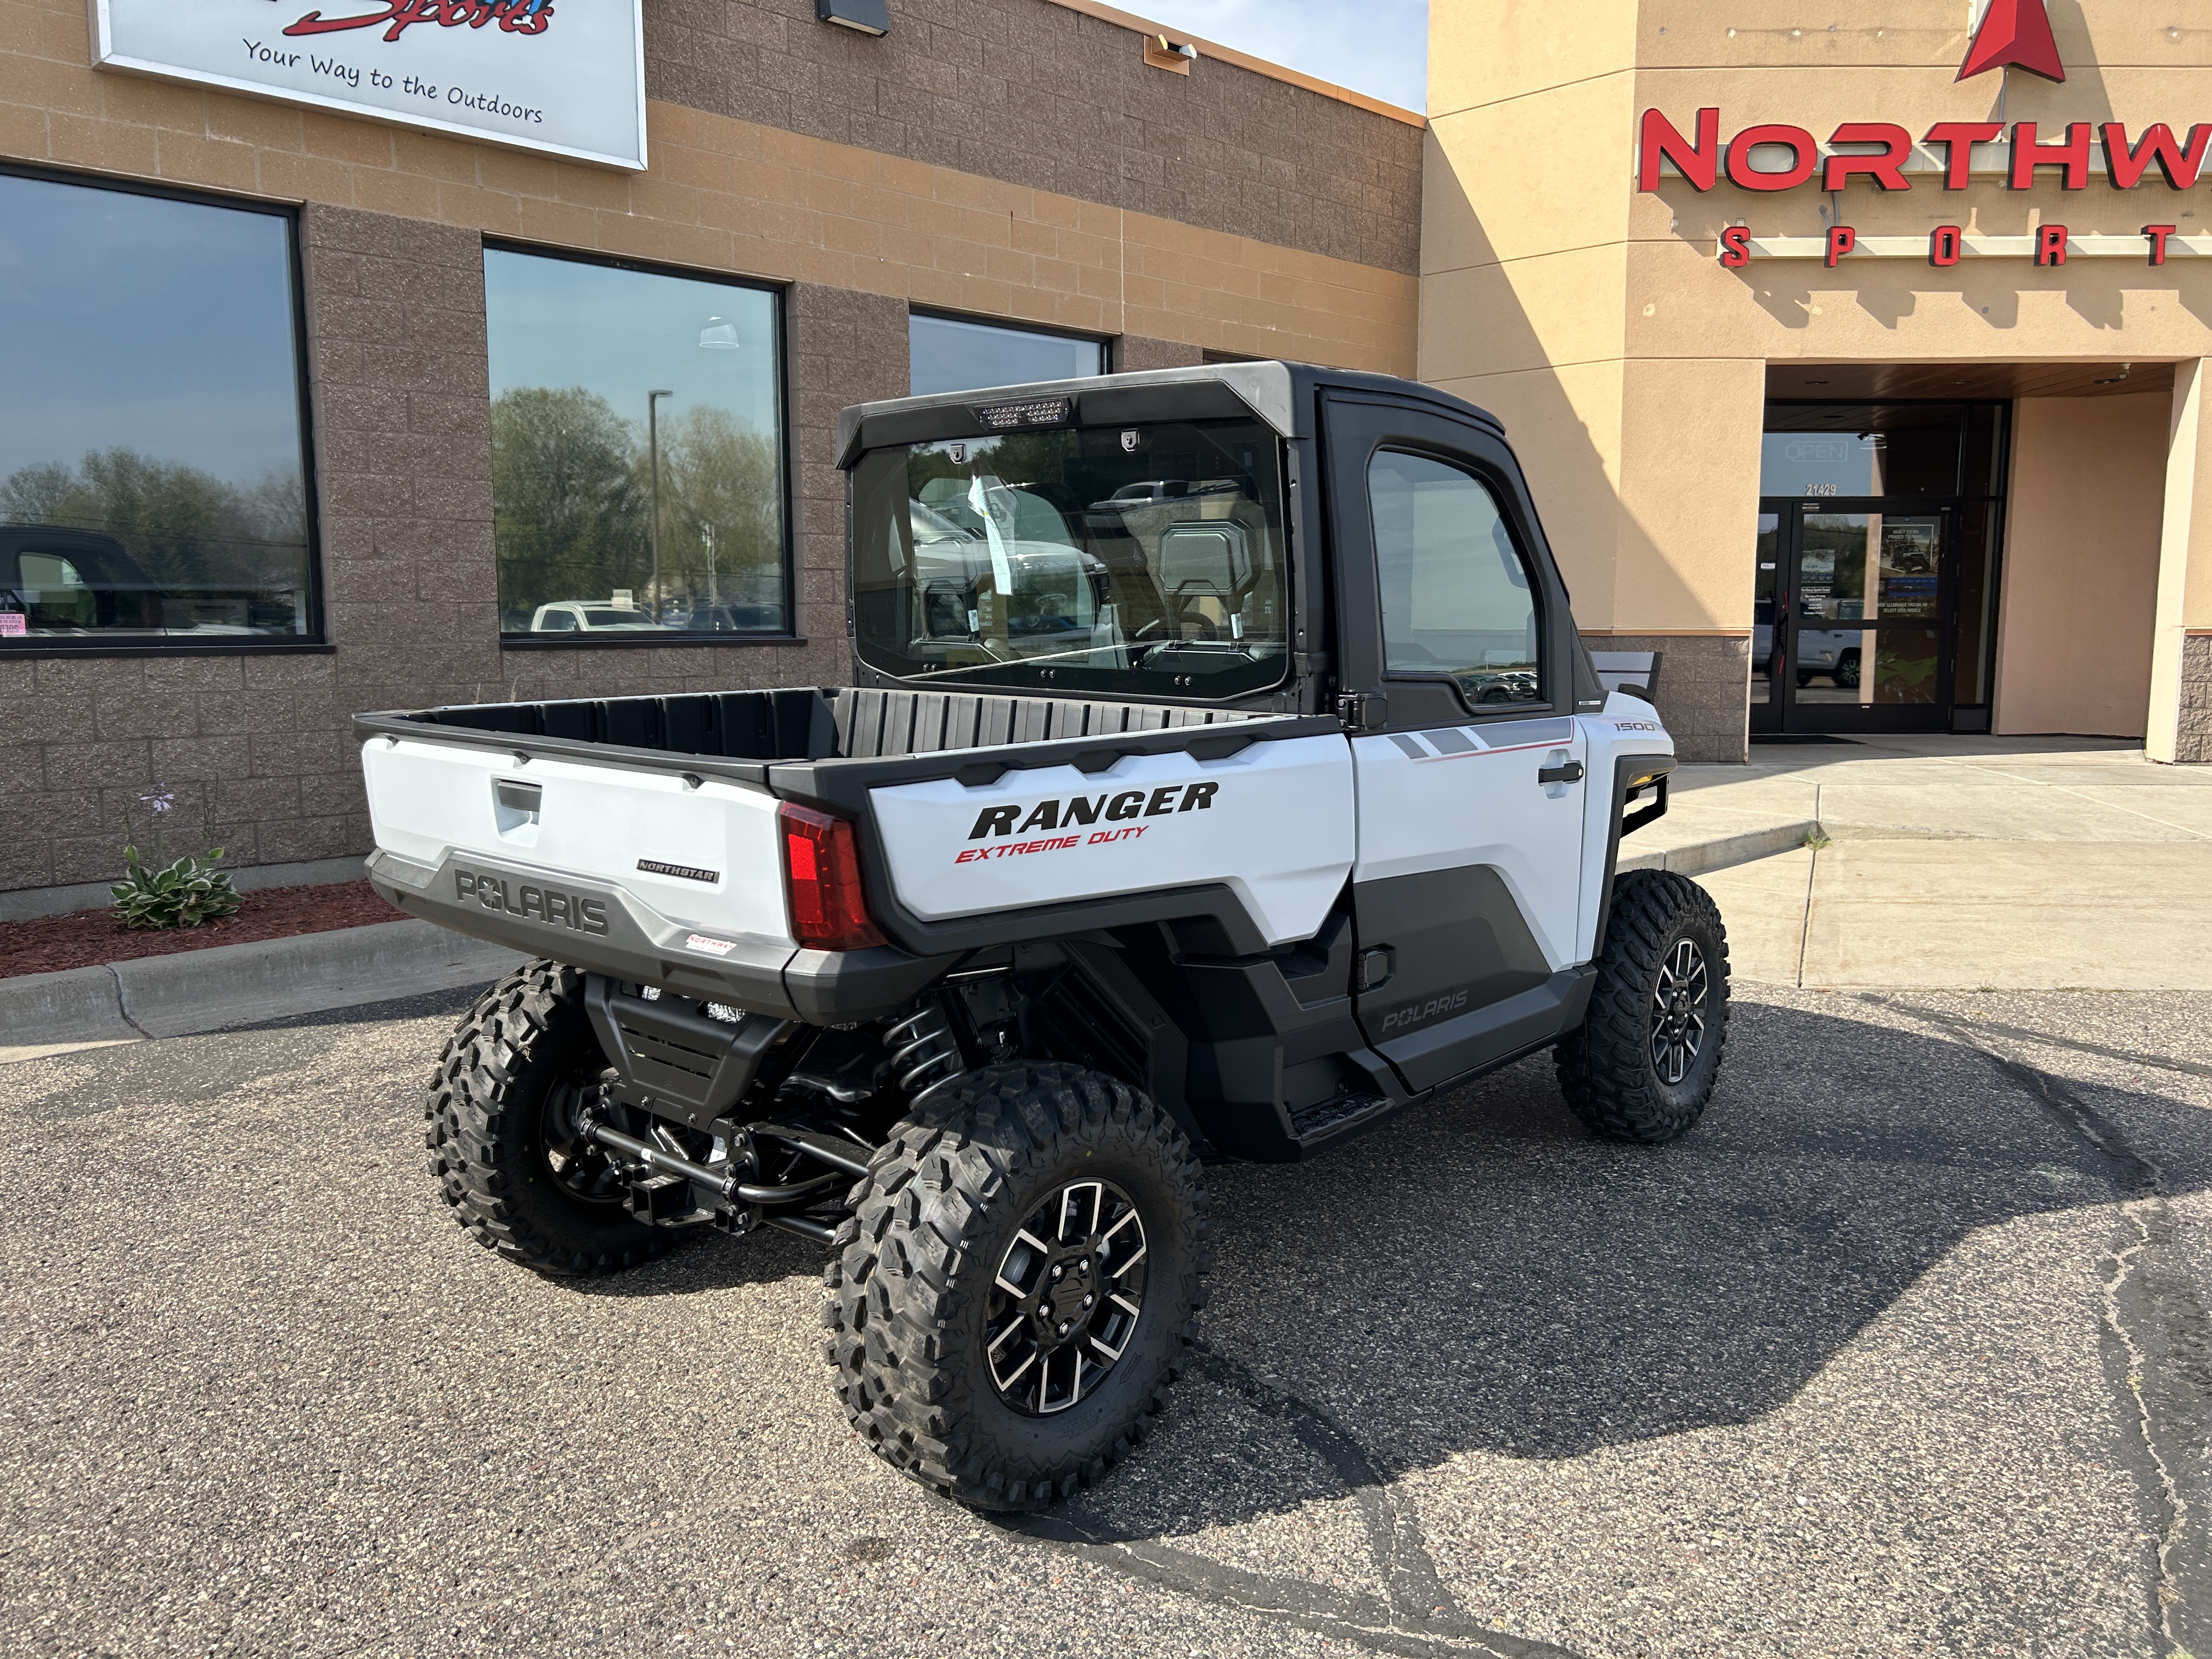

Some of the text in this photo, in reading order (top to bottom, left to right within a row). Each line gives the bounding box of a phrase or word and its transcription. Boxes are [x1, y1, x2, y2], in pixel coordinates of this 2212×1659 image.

[243, 39, 542, 123] Your Way to the Outdoors
[1786, 445, 1844, 459] OPEN
[1805, 484, 1836, 496] 21429
[1613, 723, 1655, 731] 1500
[968, 782, 1219, 840] RANGER
[955, 826, 1149, 864] EXTREME DUTY
[639, 861, 714, 881] NORTHSTAR
[455, 869, 609, 937] POLARIS
[689, 936, 733, 949] NORTHWAY
[1381, 990, 1468, 1032] POLARIS
